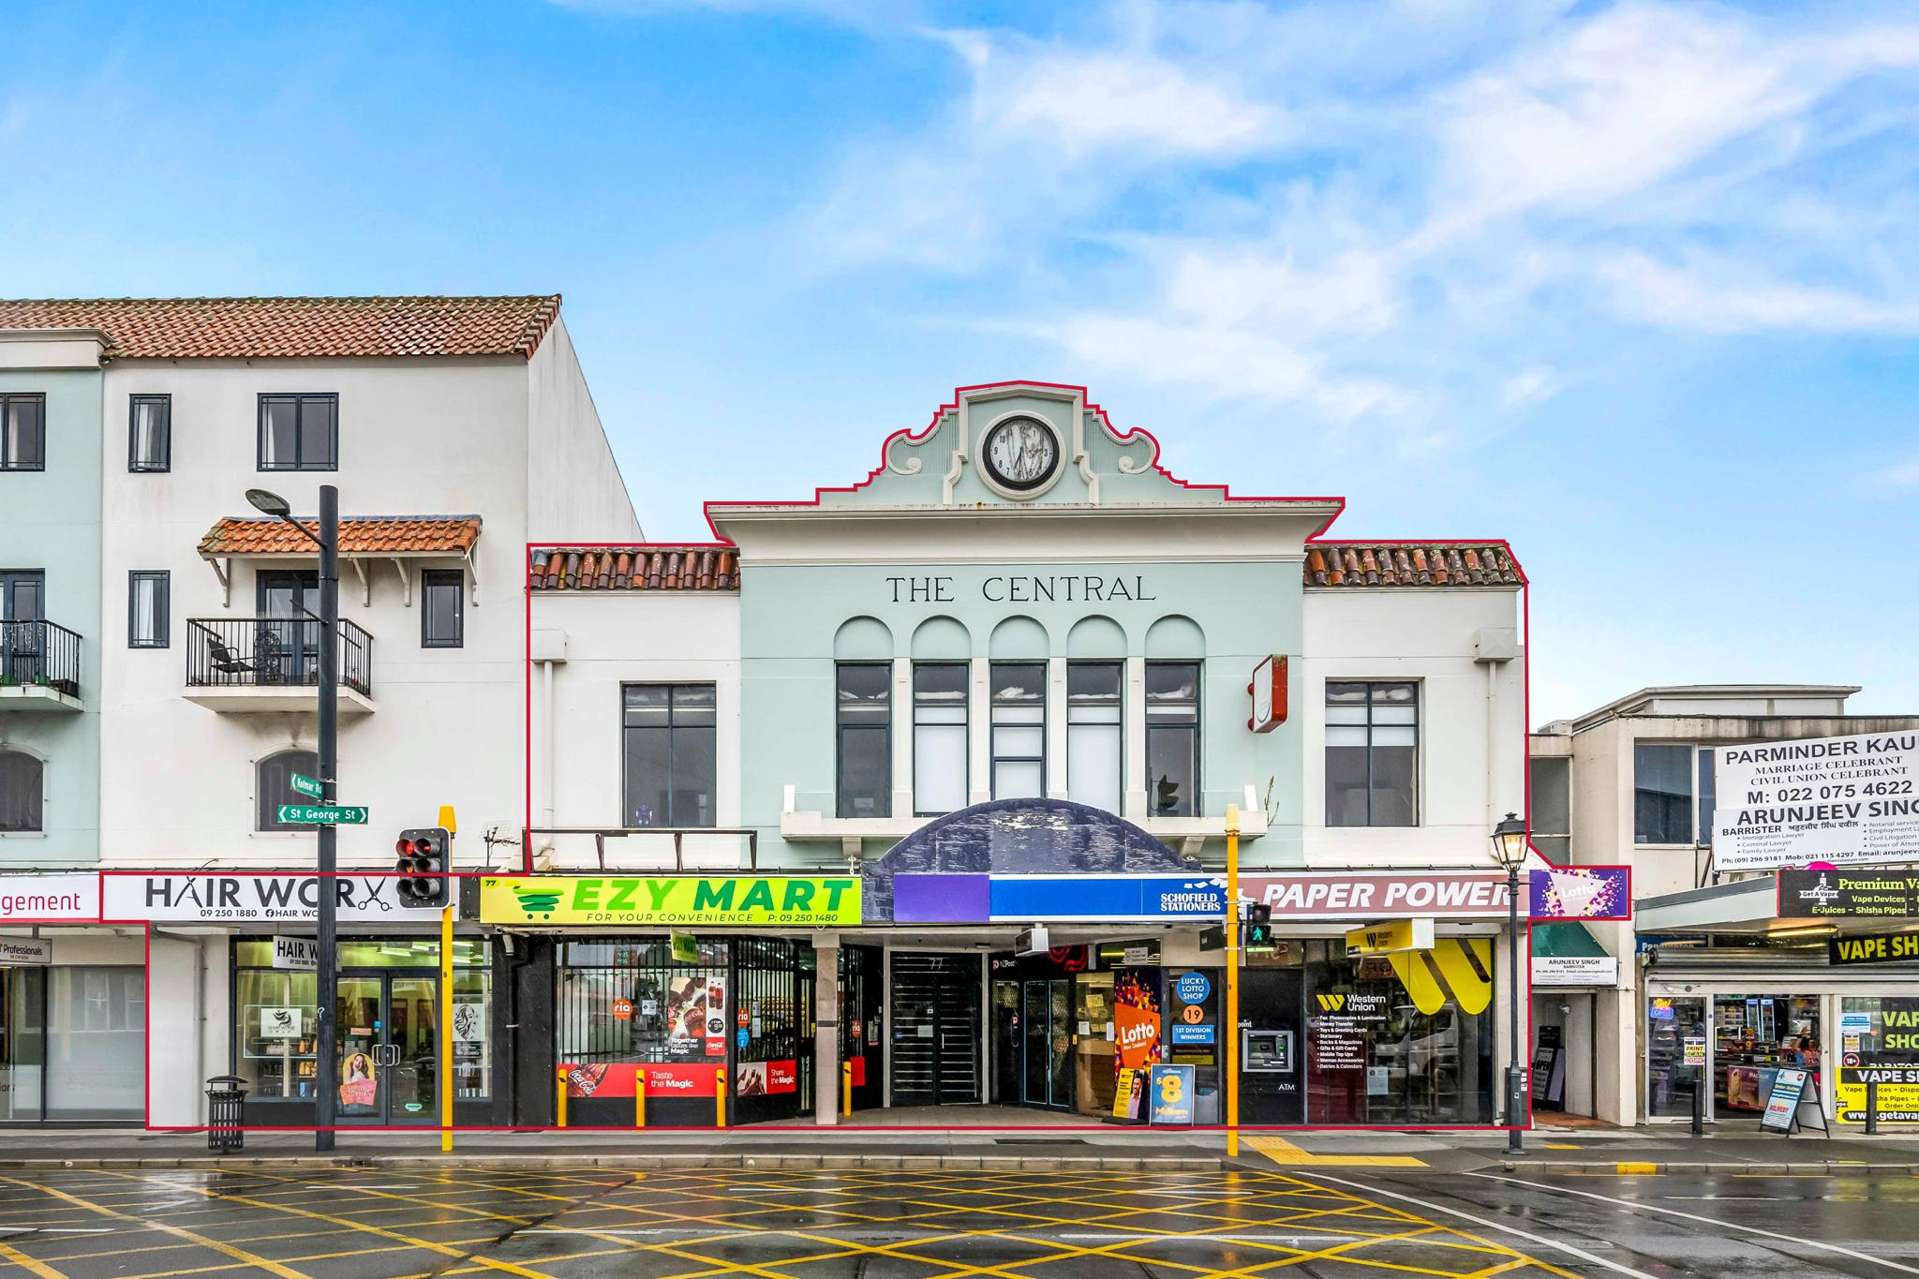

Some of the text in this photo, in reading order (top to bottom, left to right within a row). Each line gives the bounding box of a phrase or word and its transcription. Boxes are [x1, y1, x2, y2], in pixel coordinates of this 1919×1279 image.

[886, 576, 1157, 602] THE CENTRAL
[1725, 735, 1919, 766] PARMINDER KAU
[1755, 755, 1904, 776] MARRIAGE CELEBRANT
[1751, 767, 1909, 786] CIVIL UNION CELEBRANT
[1747, 780, 1913, 805] M: 022 075 4622
[291, 809, 355, 822] St George St
[1737, 802, 1862, 826] ARUNJEEV
[1722, 825, 1782, 836] BARRISTER
[485, 879, 497, 887] 77
[1838, 877, 1905, 890] Premium
[146, 877, 240, 908] HAIR
[572, 880, 853, 911] EZY MART
[1161, 893, 1218, 902] SCHOFIELD
[1262, 882, 1510, 908] PAPER POWER
[1561, 885, 1594, 898] Lotto
[2, 893, 81, 915] gement
[1852, 895, 1905, 904] Vape Devices
[1160, 902, 1221, 912] STATIONERS
[1812, 906, 1906, 915] E-Juices Shisha Pipes
[200, 909, 299, 918] 09 250 1880 HAIR
[586, 913, 838, 922] FOR YOUR CONVENIENCE P: 09 250 1480
[277, 941, 305, 959] HAIR
[1838, 938, 1887, 960] VAPE
[1181, 977, 1205, 985] LUCKY
[1346, 994, 1386, 1003] Western
[1347, 1002, 1376, 1011] Union
[1187, 1009, 1200, 1019] 19
[1121, 1023, 1155, 1044] Lotto
[651, 1071, 674, 1080] Taste
[1857, 1070, 1903, 1083] VAPE
[650, 1080, 694, 1089] the Magic
[1278, 1083, 1295, 1091] ATM
[1845, 1086, 1863, 1094] Vape
[1890, 1095, 1909, 1103] Pipes
